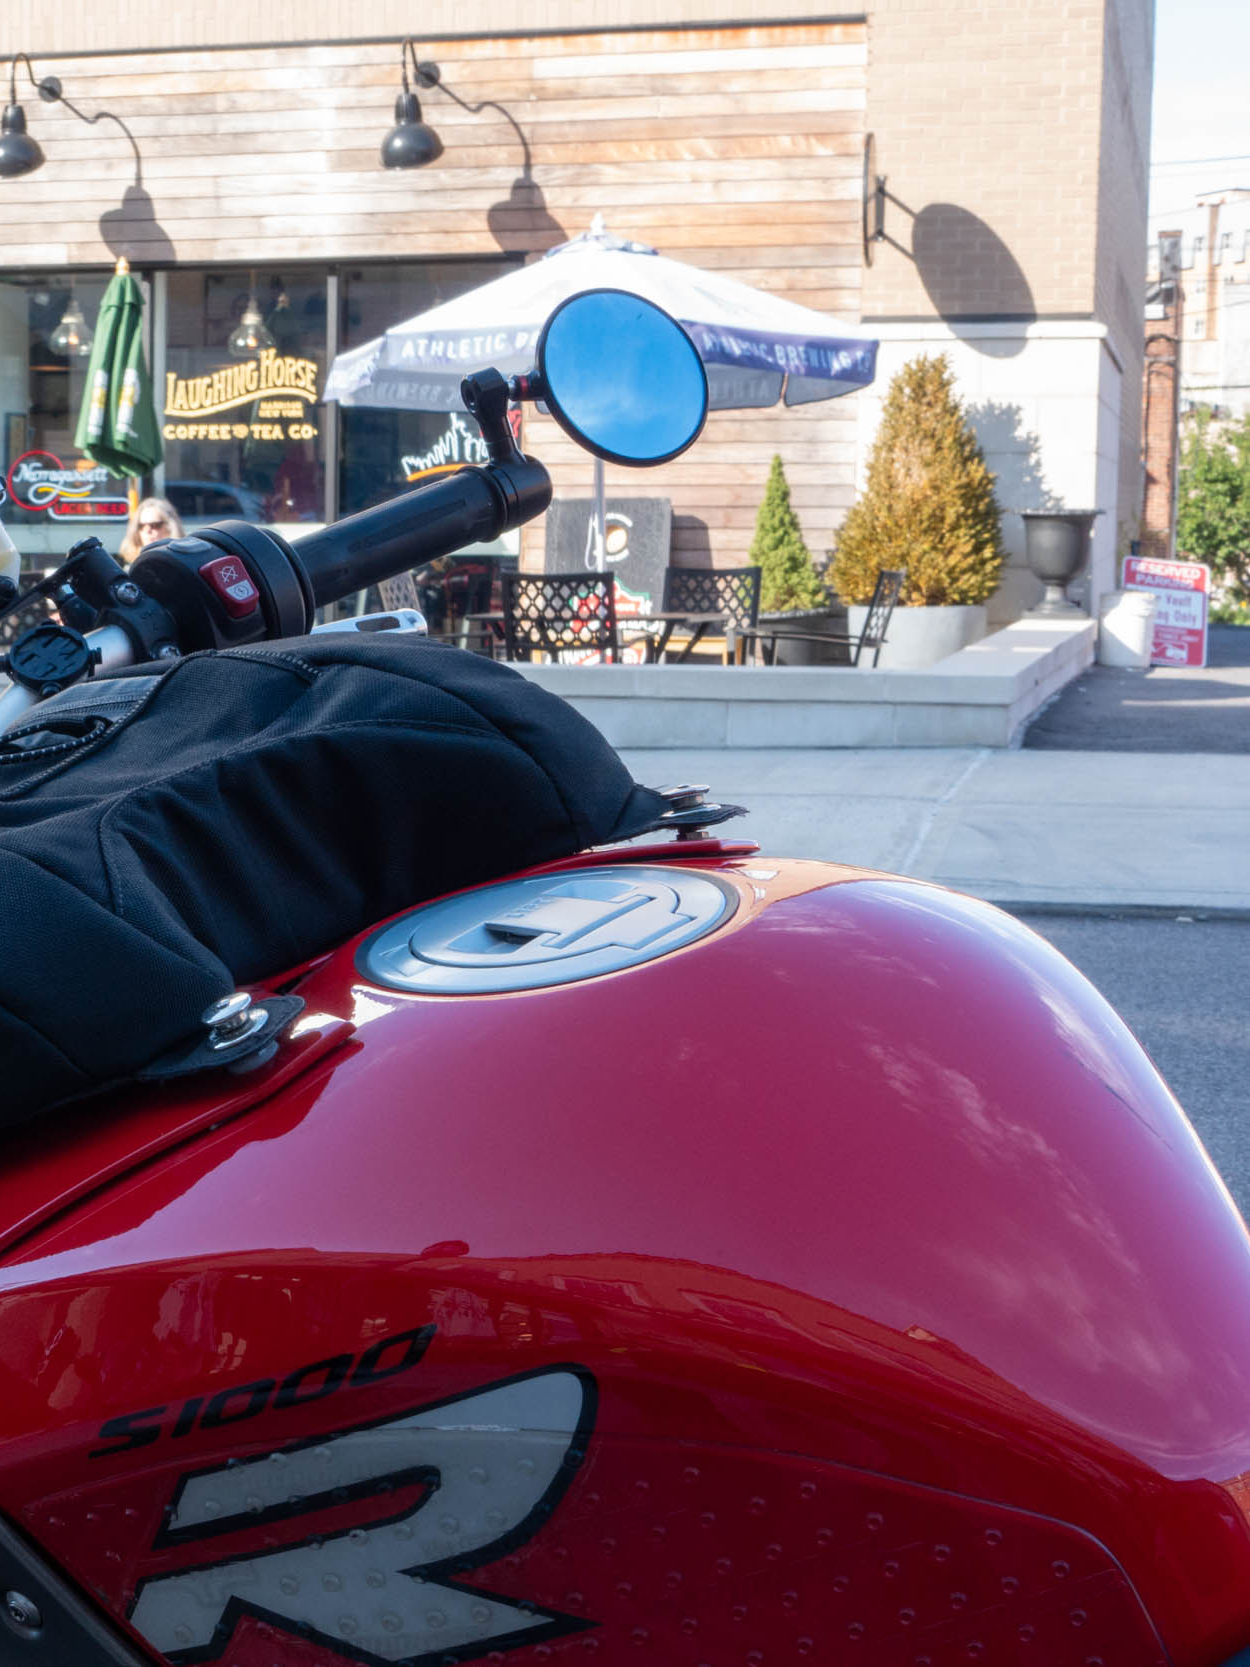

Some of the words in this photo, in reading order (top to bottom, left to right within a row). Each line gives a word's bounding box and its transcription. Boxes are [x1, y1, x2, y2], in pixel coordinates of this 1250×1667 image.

[401, 332, 506, 359] ATHLETIC
[166, 360, 259, 410] LAUGHING
[259, 347, 318, 394] HORSE
[163, 423, 232, 440] COFFEE
[250, 423, 284, 440] TEA
[1131, 560, 1202, 580] RESERVED
[88, 1323, 438, 1459] S1000
[125, 1361, 601, 1667] R
